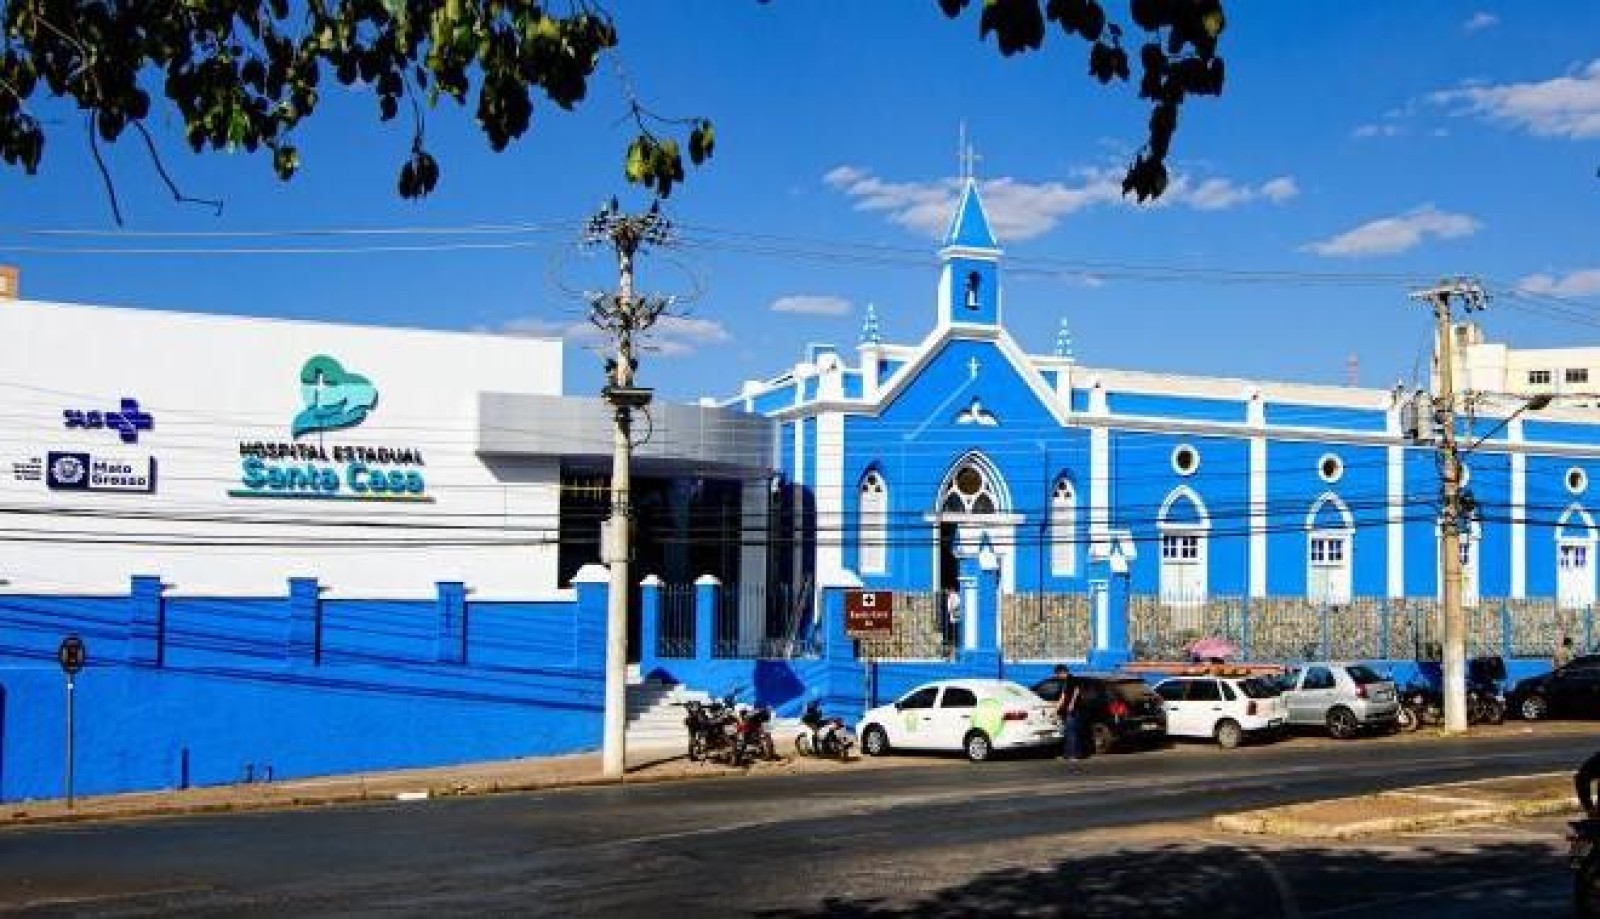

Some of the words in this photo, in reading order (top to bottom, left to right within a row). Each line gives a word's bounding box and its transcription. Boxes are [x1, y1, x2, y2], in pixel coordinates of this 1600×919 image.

[239, 441, 330, 462] HOSPITAL
[332, 445, 425, 465] ESTADUAL
[91, 474, 147, 486] Grosso
[242, 456, 340, 490] Santa
[345, 462, 425, 493] Casa
